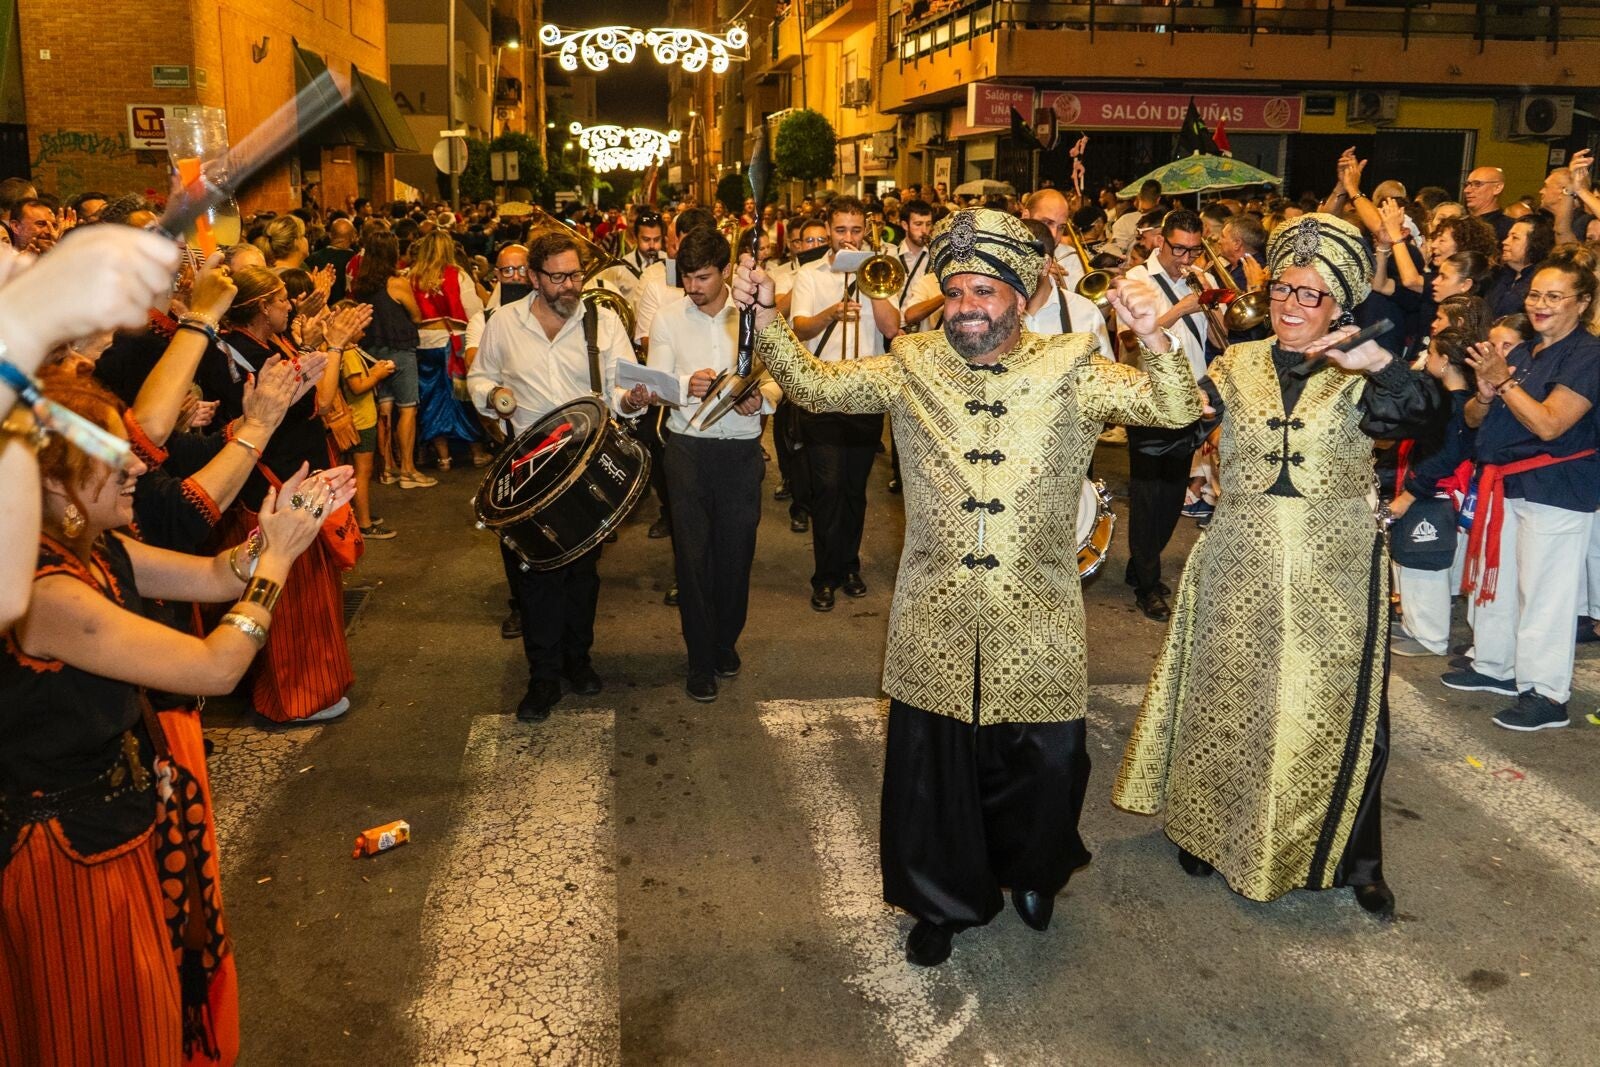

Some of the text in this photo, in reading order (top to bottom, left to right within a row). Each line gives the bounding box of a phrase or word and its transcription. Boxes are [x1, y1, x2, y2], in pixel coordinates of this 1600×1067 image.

[985, 88, 1024, 102] Salón de
[991, 102, 1012, 115] UÑA
[1101, 101, 1244, 122] SALÓN DE UÑAS
